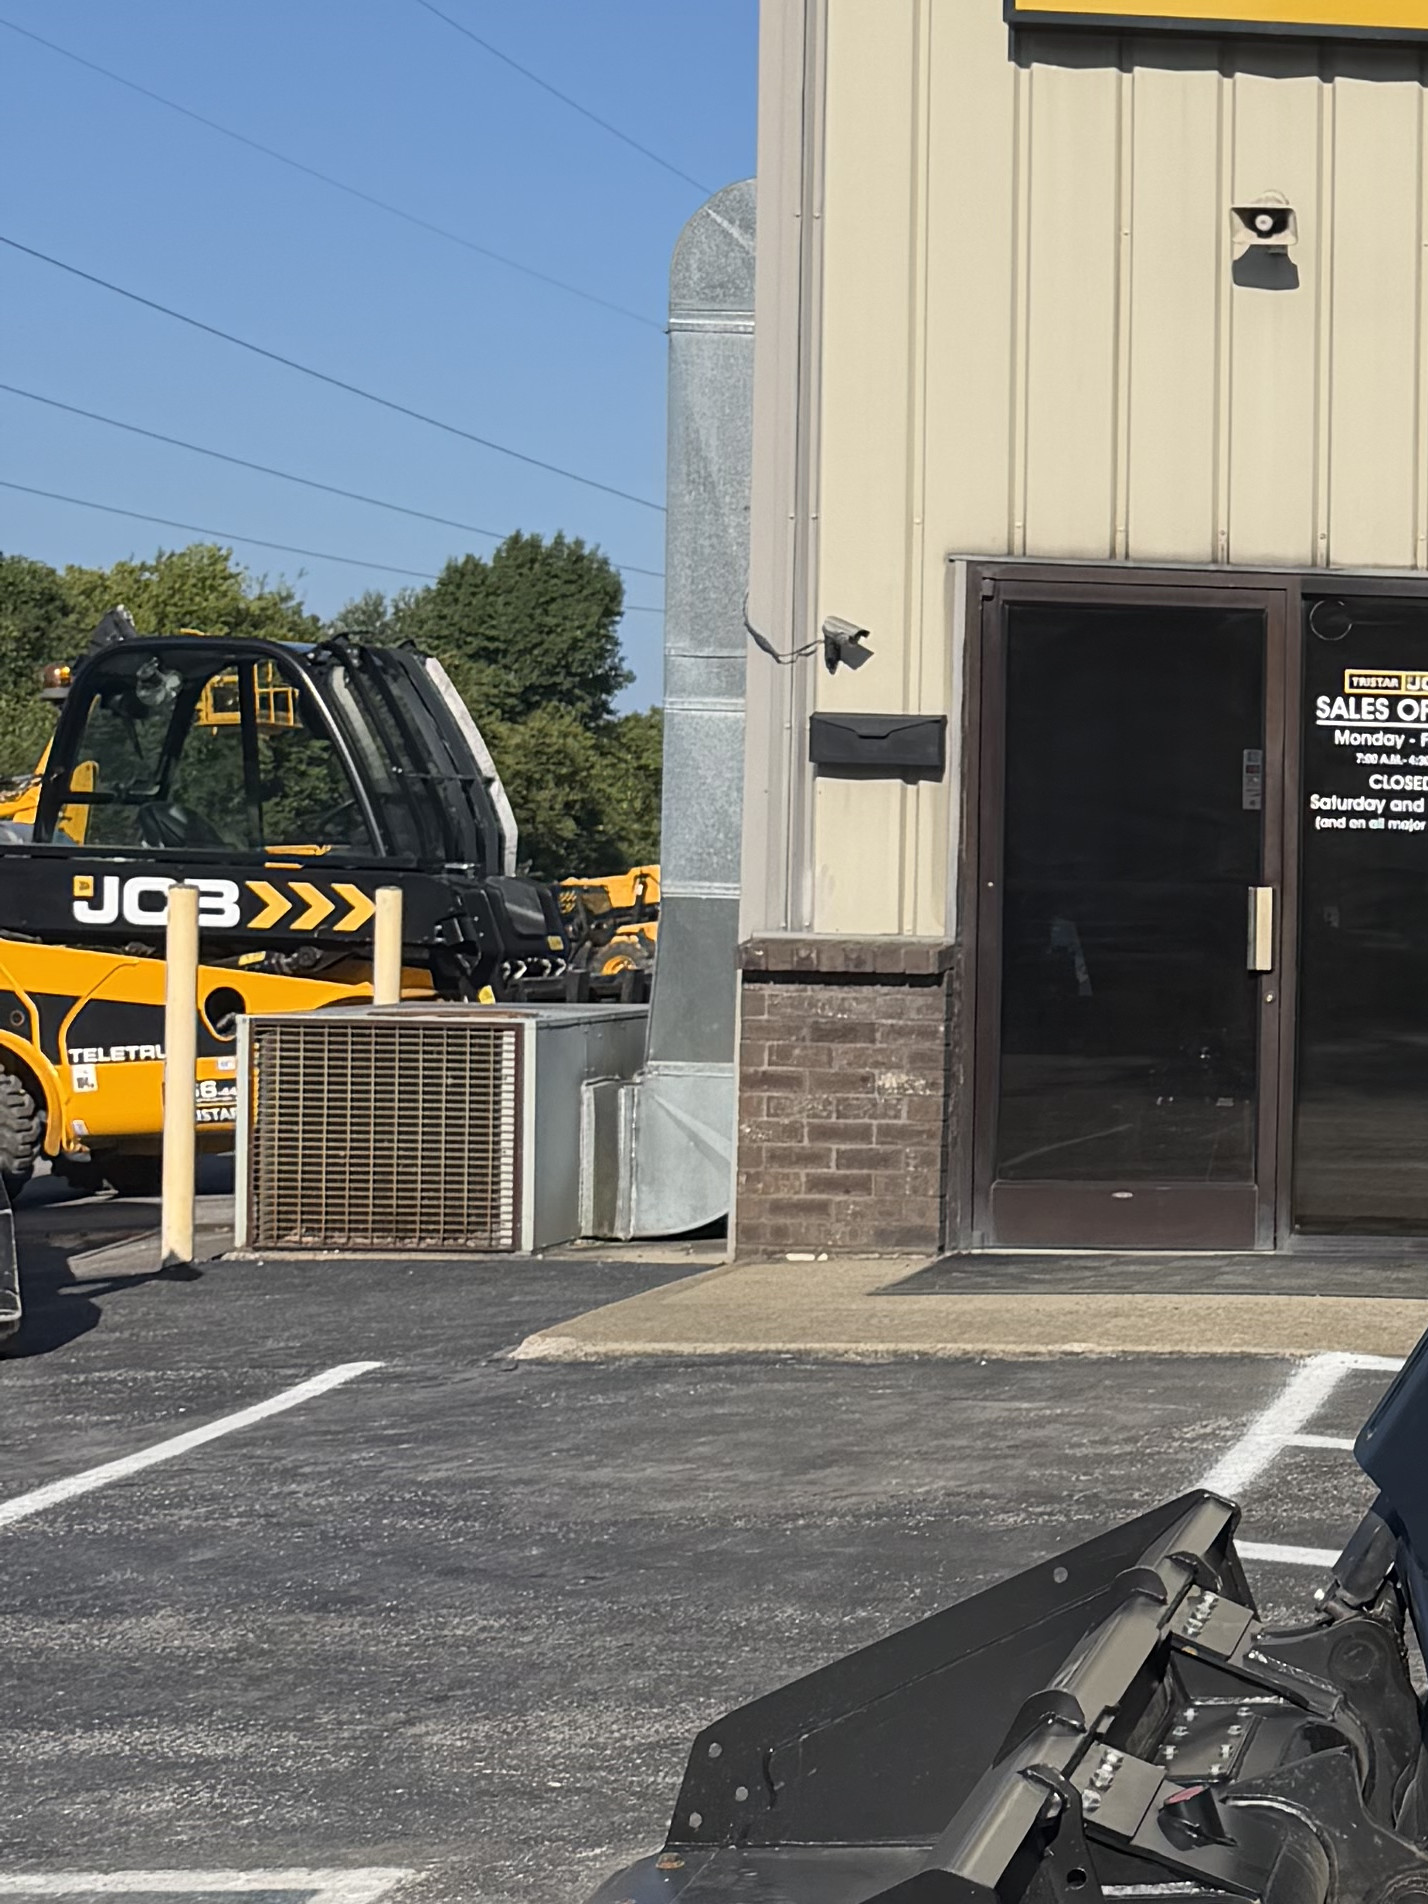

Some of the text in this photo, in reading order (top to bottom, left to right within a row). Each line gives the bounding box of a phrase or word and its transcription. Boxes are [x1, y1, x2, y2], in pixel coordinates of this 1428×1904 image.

[1352, 677, 1399, 688] TRISTAR
[1316, 696, 1390, 721] SALES
[1334, 729, 1405, 750] Monday
[1310, 794, 1386, 815] Saturday
[1390, 798, 1424, 813] and
[1315, 816, 1347, 831] (and
[1368, 818, 1385, 830] all
[1388, 818, 1425, 833] major
